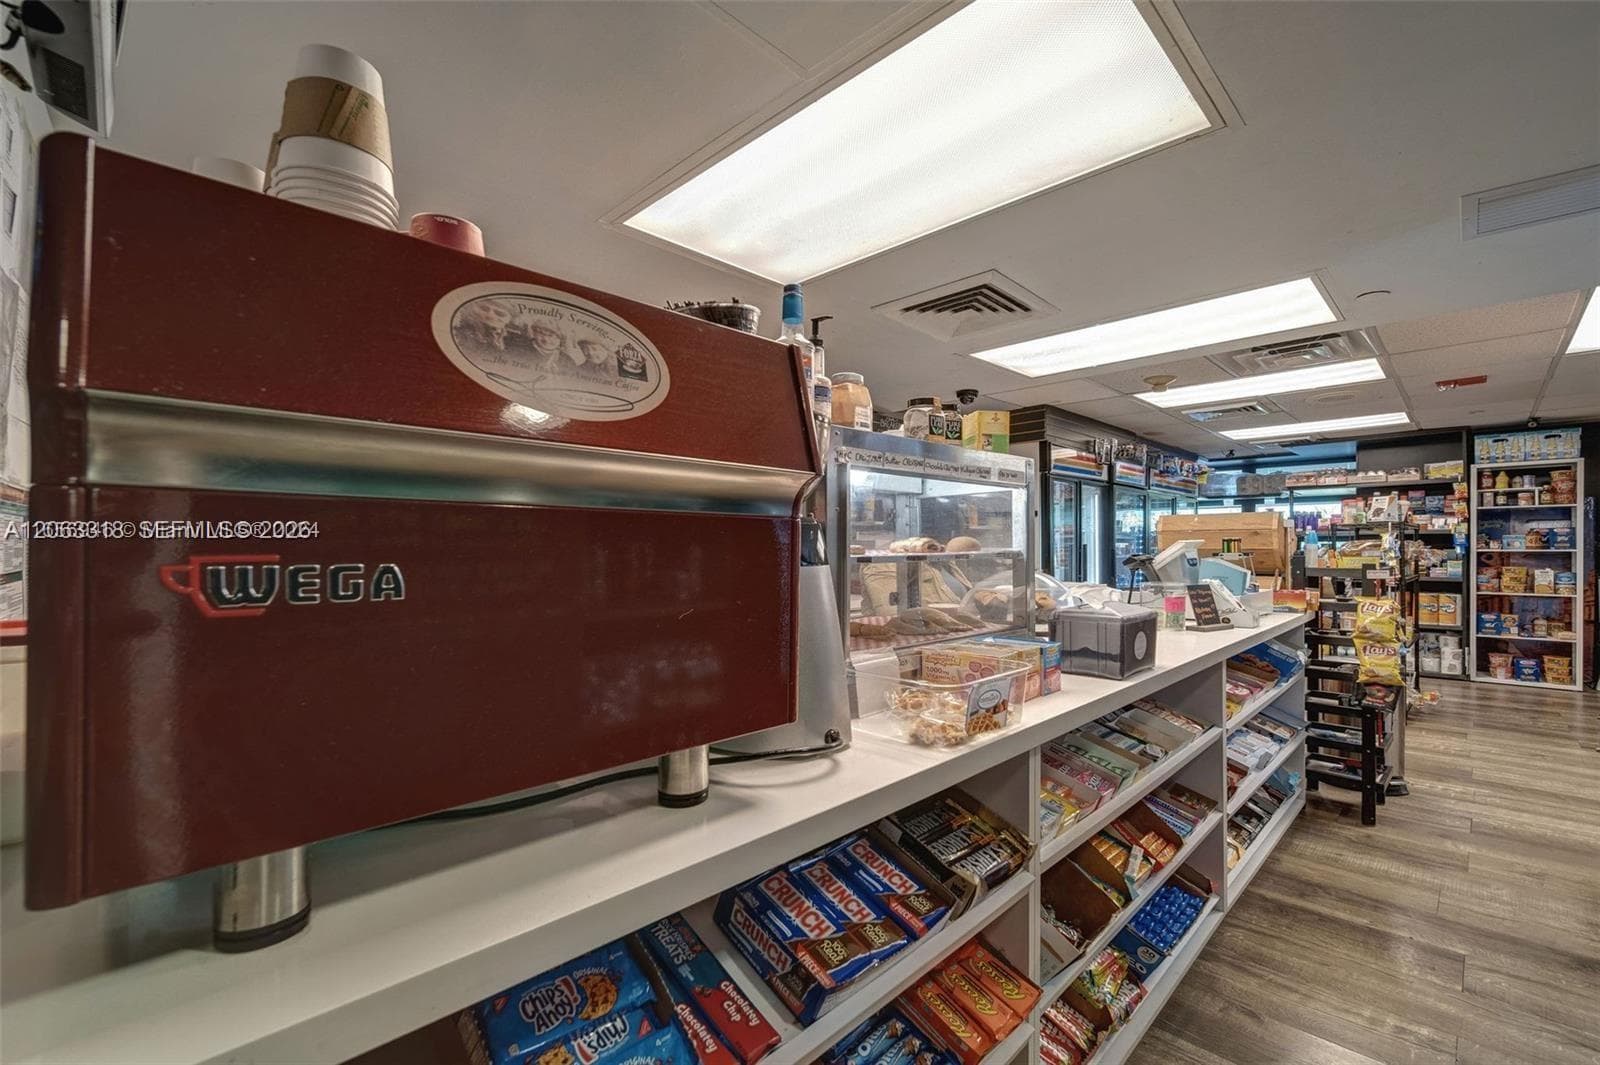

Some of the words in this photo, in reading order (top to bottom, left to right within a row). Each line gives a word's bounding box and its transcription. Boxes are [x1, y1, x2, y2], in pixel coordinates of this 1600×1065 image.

[517, 303, 564, 321] Proudly
[205, 563, 406, 608] WEGA
[850, 839, 915, 894] CRUNCH
[762, 872, 833, 939] CRUNCH
[805, 863, 871, 923] CRUNCH
[652, 925, 688, 964] TREATS
[734, 909, 791, 971] CRUNCH
[820, 939, 844, 964] Real
[519, 982, 565, 1021] Chips
[719, 980, 761, 1026] Chocolatey
[722, 999, 742, 1022] Chip
[675, 1002, 718, 1054] Chocolatey
